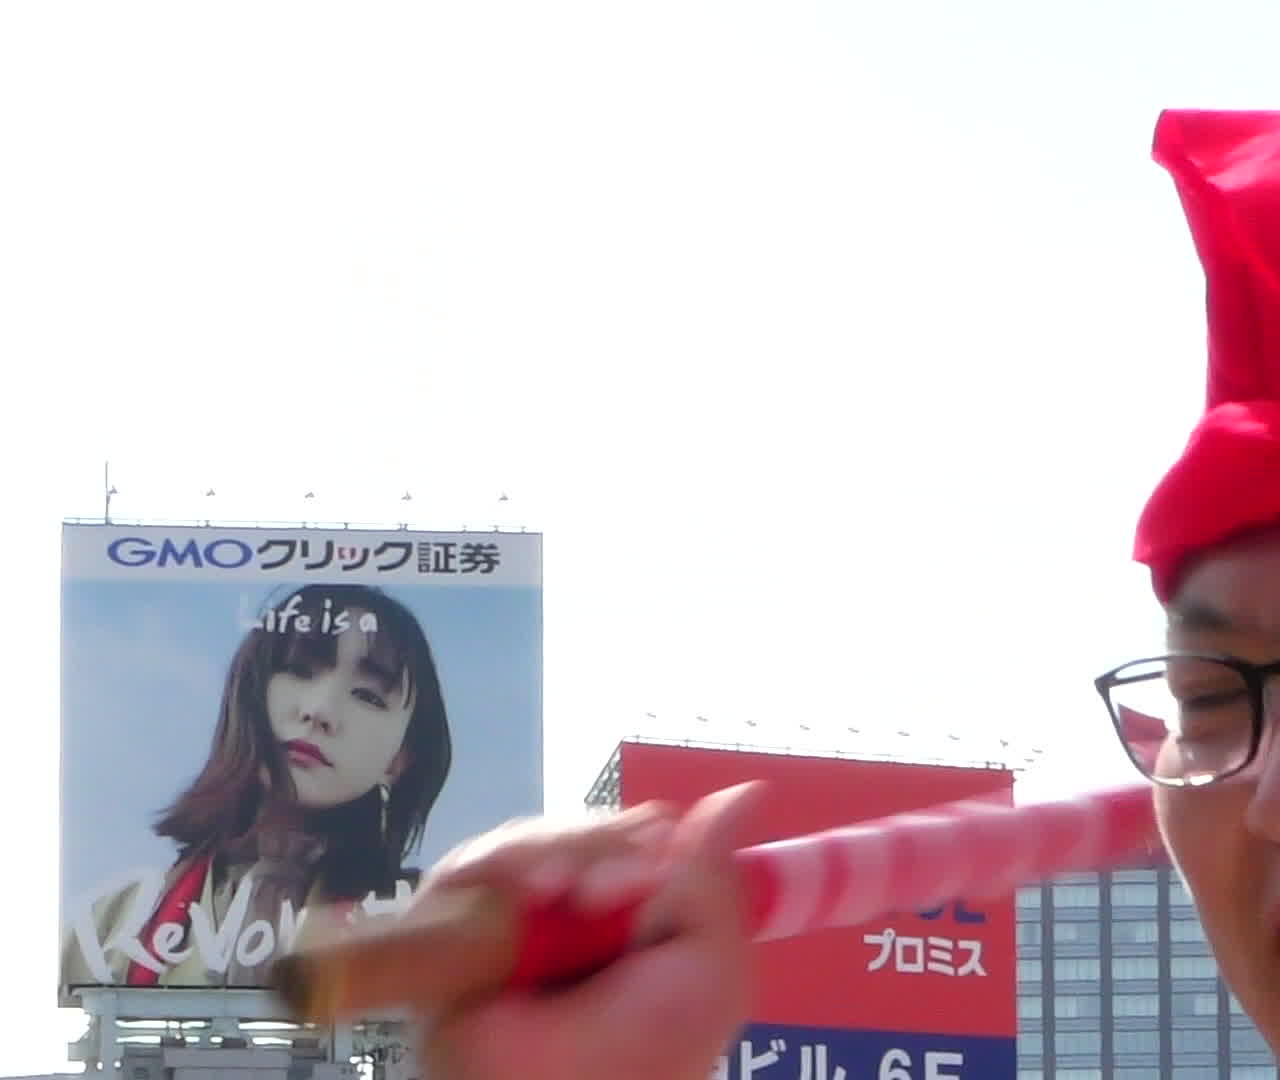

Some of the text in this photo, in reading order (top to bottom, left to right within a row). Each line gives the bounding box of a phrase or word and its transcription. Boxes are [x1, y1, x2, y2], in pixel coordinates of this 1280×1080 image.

[359, 612, 378, 633] a
[863, 928, 988, 977] プロミス
